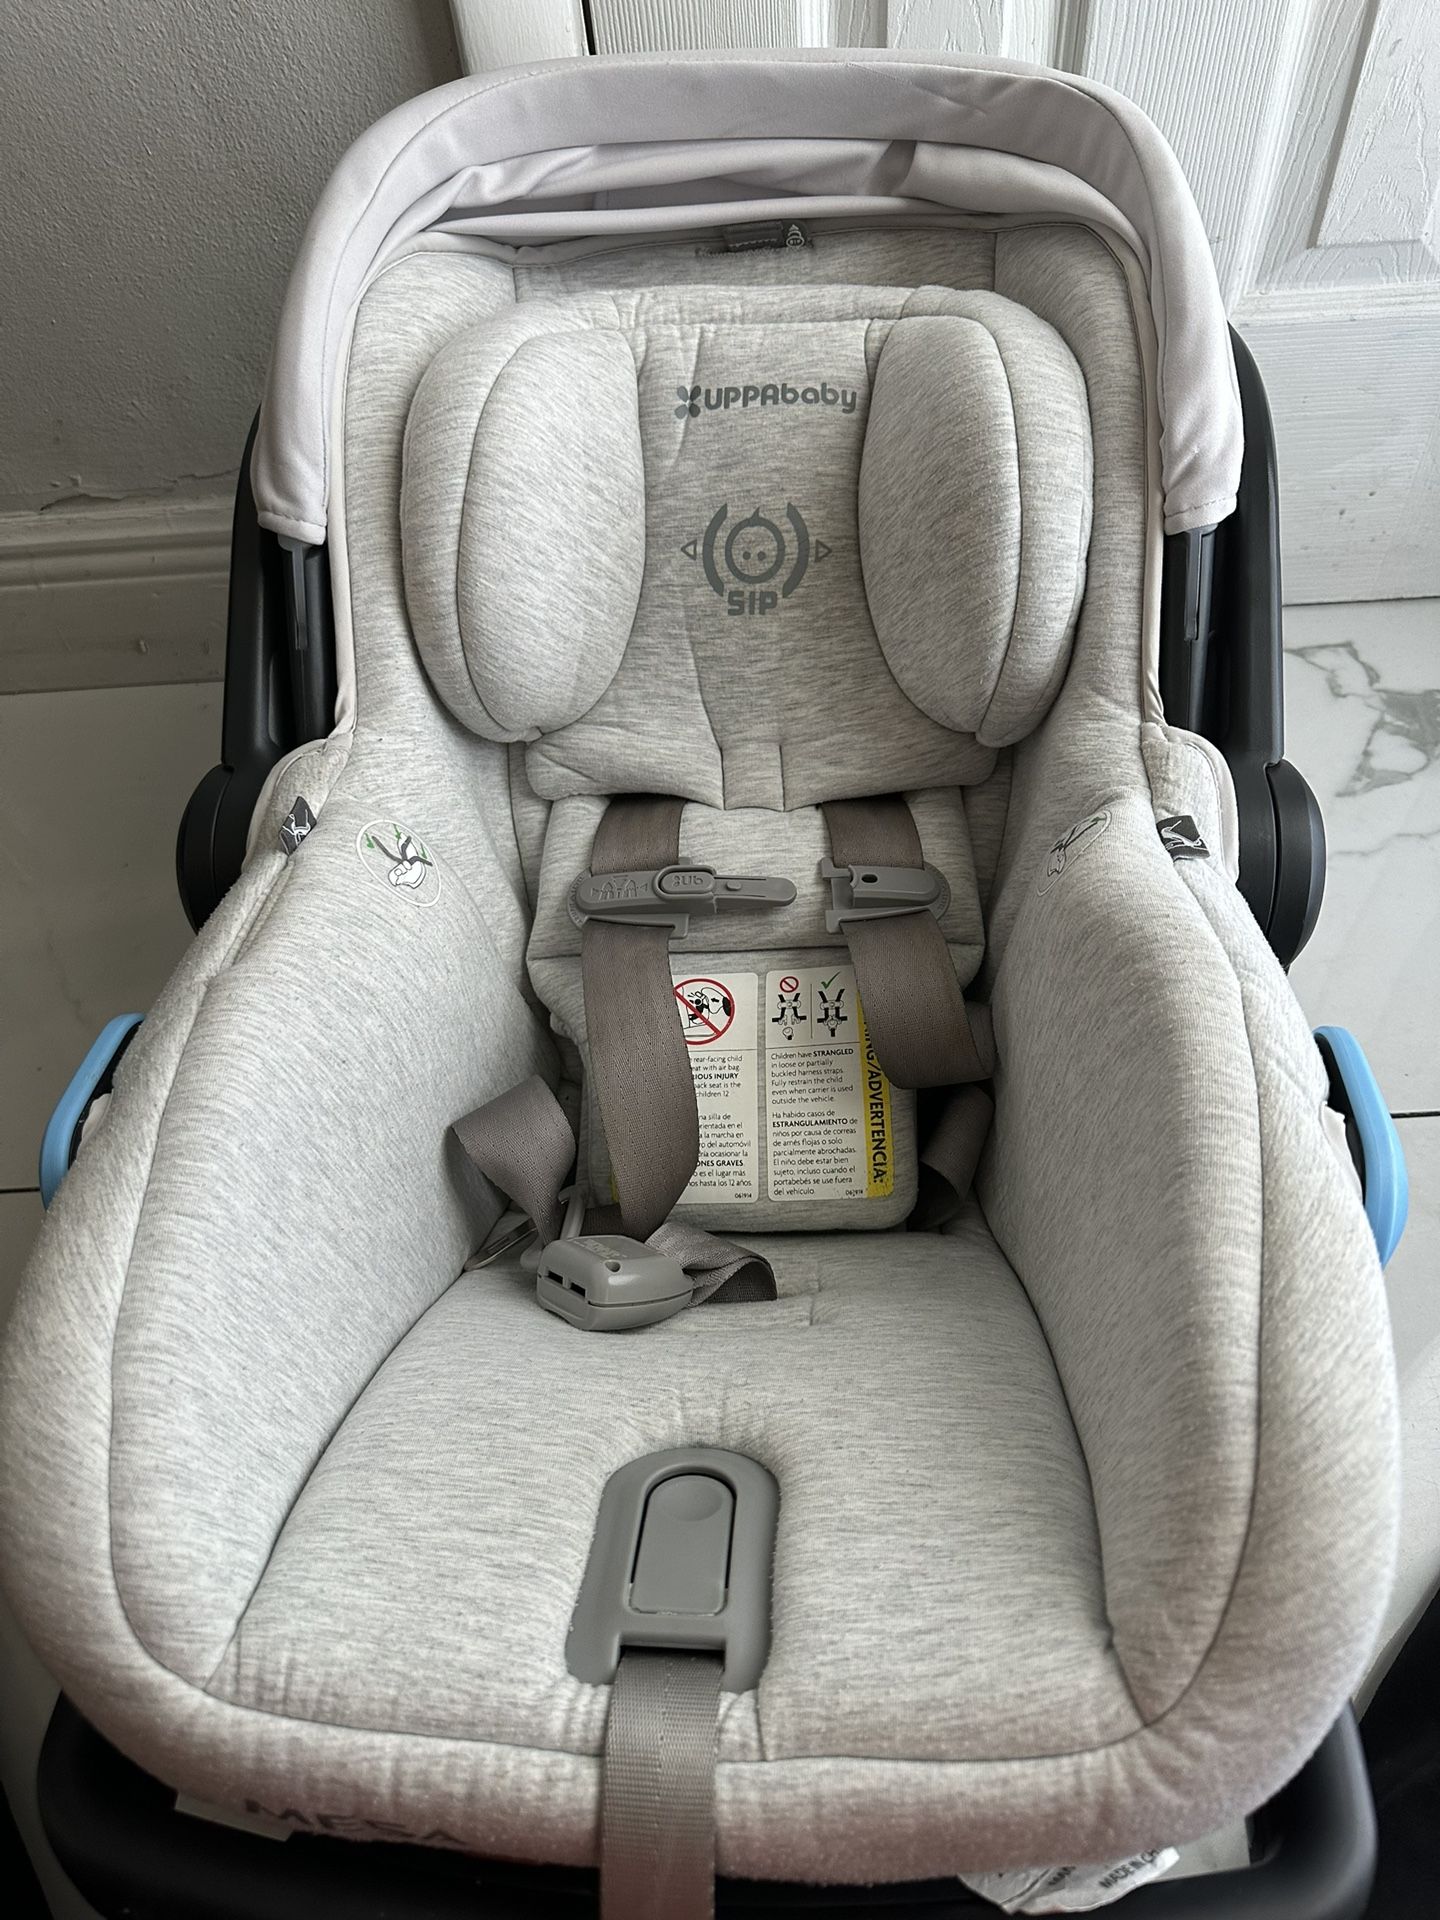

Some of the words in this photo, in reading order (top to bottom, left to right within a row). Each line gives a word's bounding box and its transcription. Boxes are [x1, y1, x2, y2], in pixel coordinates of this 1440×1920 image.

[704, 383, 857, 414] UPPAbaby
[727, 590, 778, 616] SIP
[813, 1049, 853, 1057] STRANGLED
[807, 1060, 833, 1068] partially
[773, 1118, 848, 1127] ESTRANGULAMIENTO
[802, 1138, 820, 1146] flojas
[716, 1170, 731, 1178] lugar
